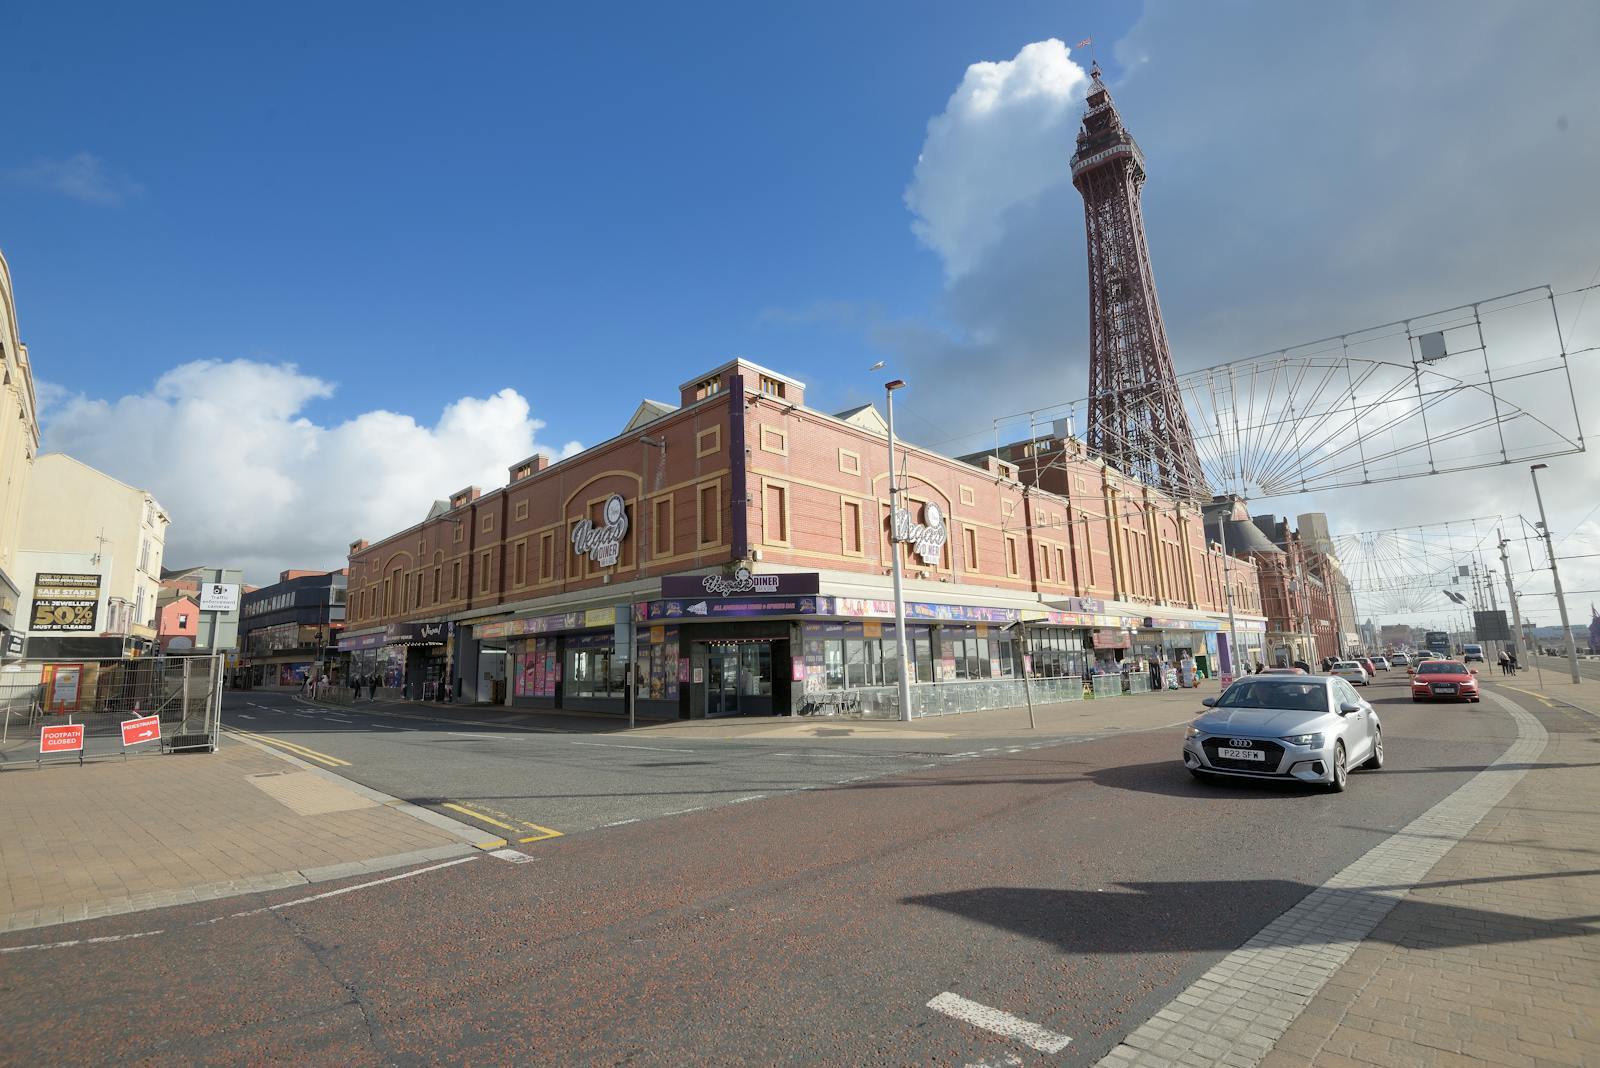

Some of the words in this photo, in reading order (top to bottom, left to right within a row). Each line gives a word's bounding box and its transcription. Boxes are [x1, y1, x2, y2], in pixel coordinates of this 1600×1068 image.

[571, 517, 628, 560] Vegas
[598, 543, 618, 558] DINER
[703, 575, 753, 597] Vegas
[753, 576, 778, 586] DINER
[33, 606, 93, 625] 50%
[44, 731, 81, 739] FOOTPATH
